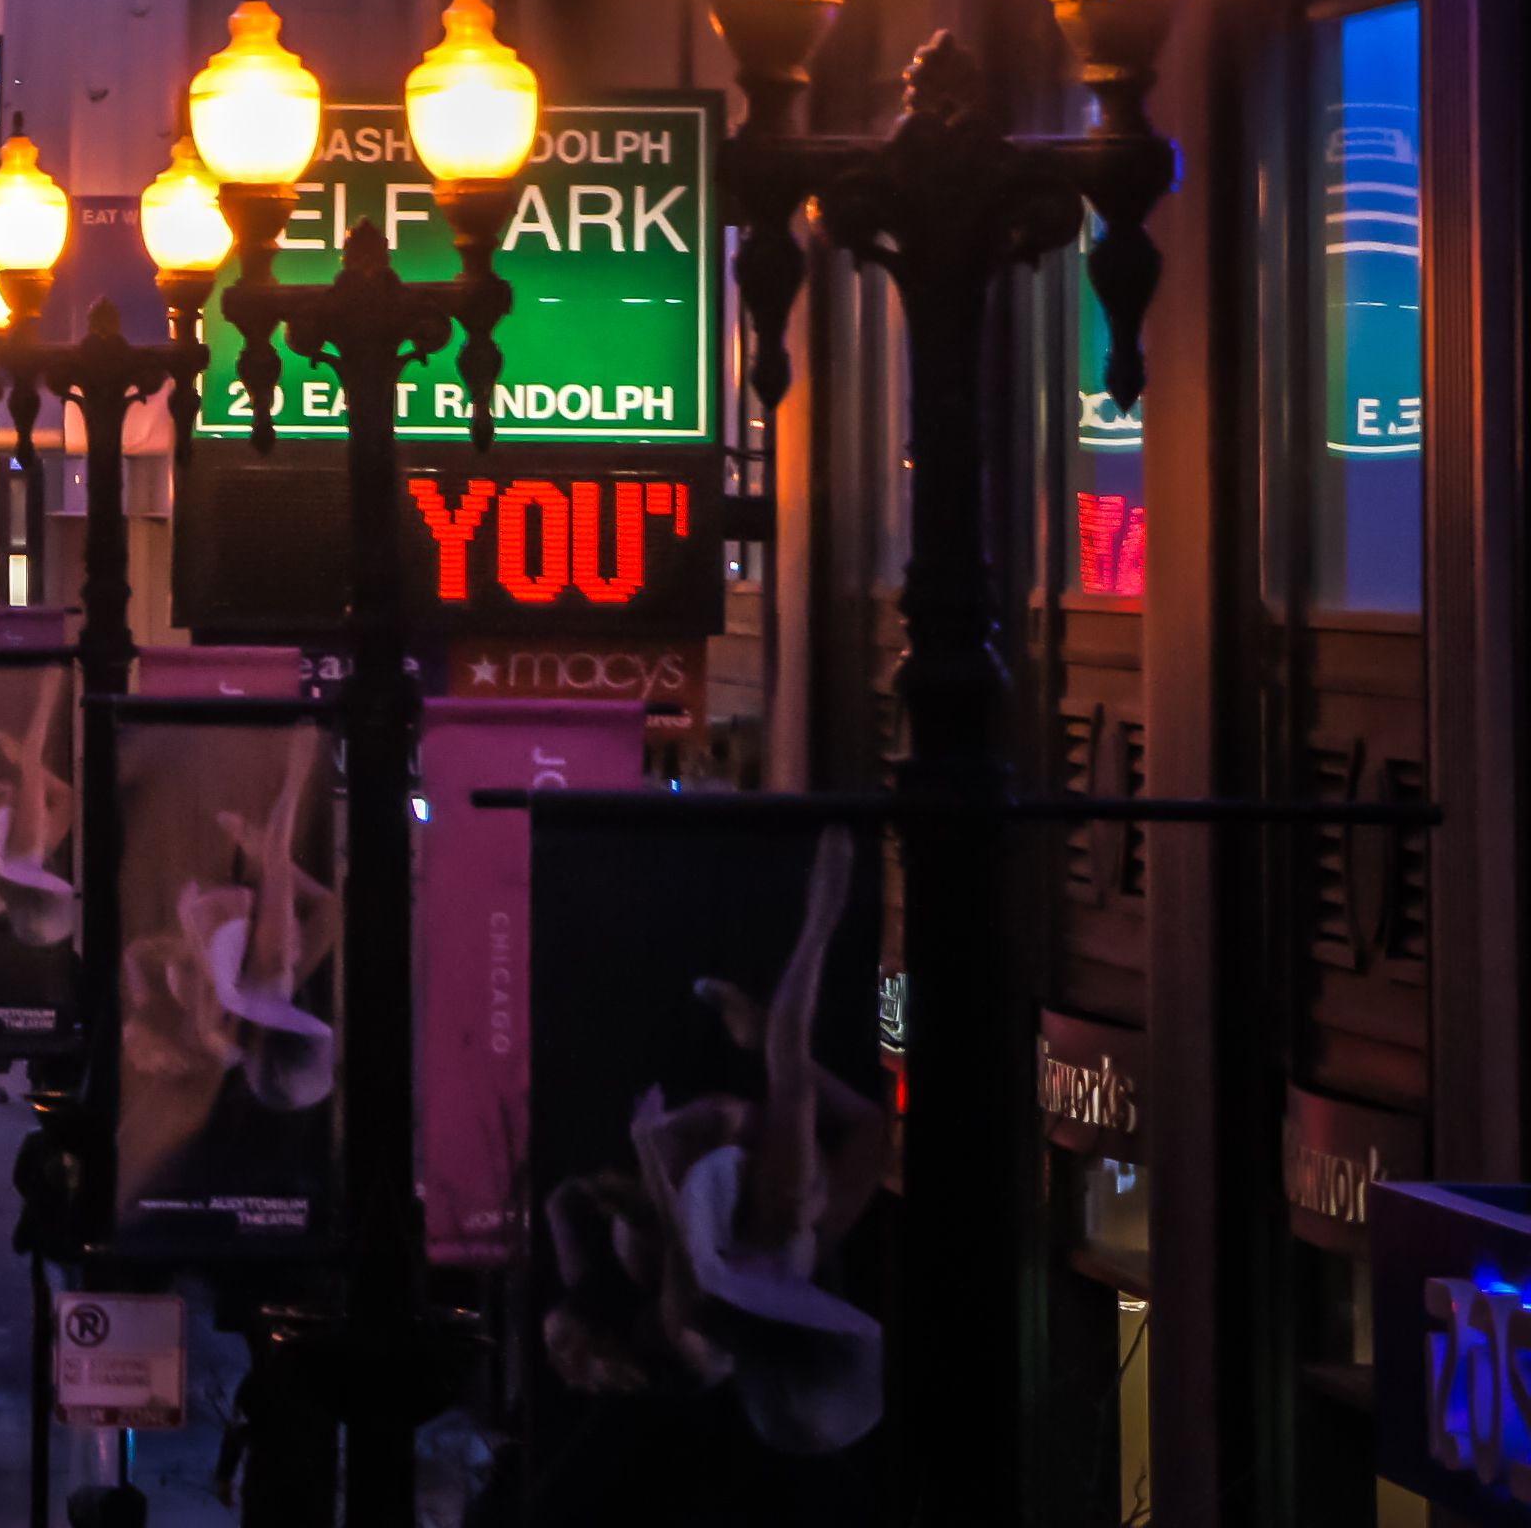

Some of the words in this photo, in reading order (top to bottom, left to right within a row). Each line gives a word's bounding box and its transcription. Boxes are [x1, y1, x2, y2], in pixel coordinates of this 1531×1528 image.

[536, 129, 671, 166] DOLPH
[502, 184, 690, 253] ARK
[302, 382, 417, 419] EAT
[489, 911, 512, 1056] CHICAGO
